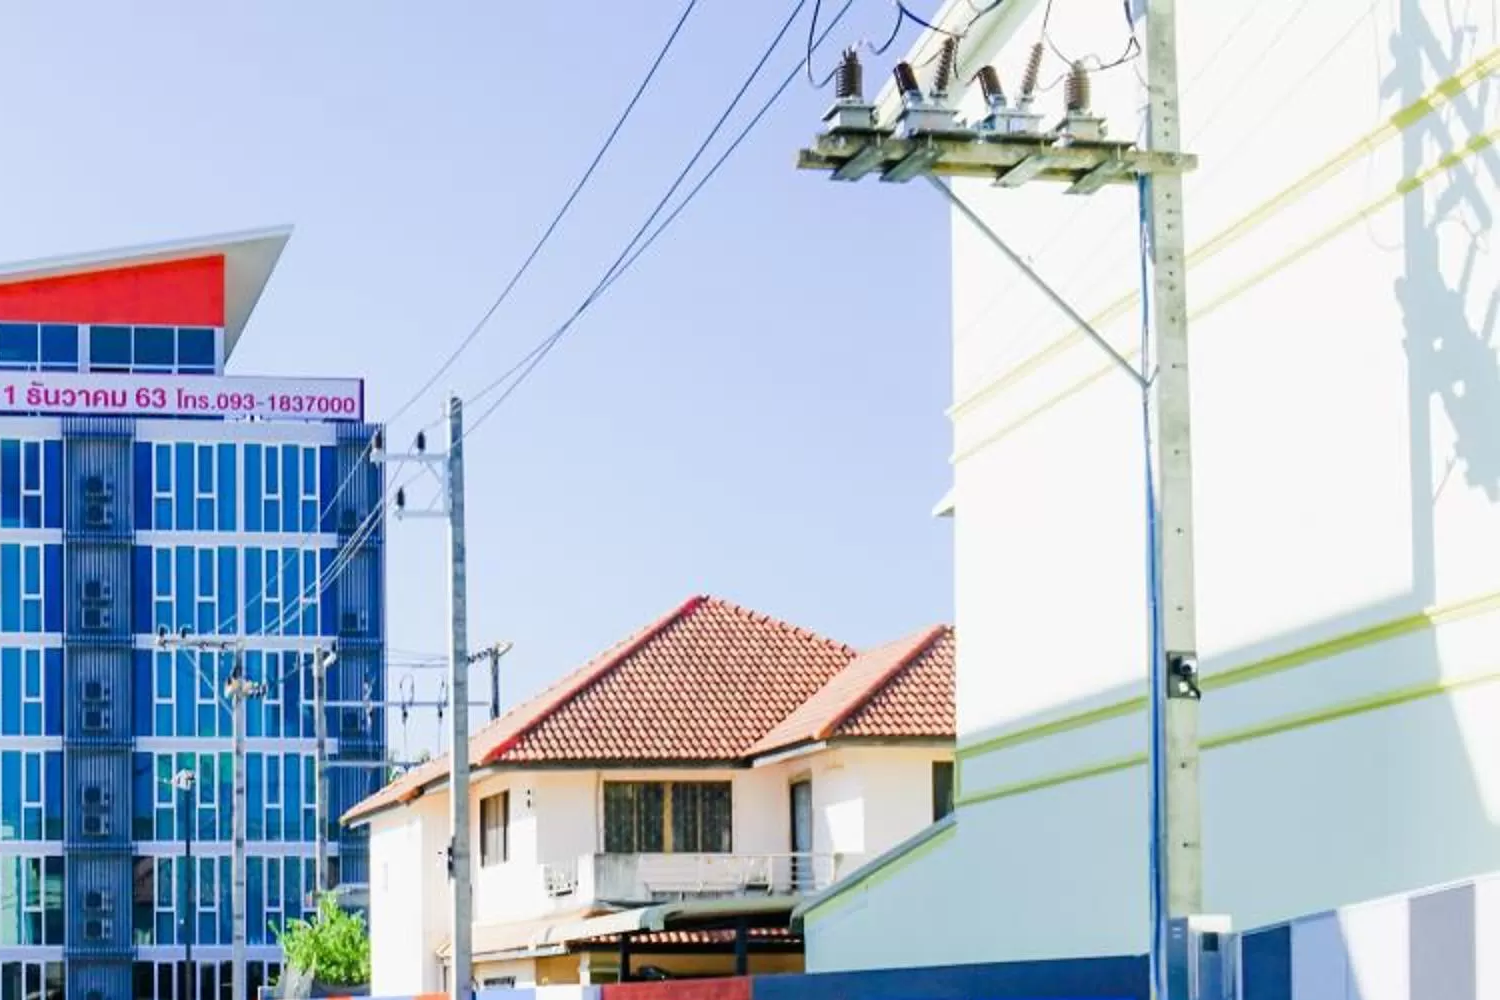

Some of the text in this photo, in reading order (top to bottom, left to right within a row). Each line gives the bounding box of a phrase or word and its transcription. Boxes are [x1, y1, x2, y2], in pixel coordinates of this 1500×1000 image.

[4, 384, 16, 405] 1
[26, 381, 127, 408] ธันวาคม
[135, 387, 167, 408] 63
